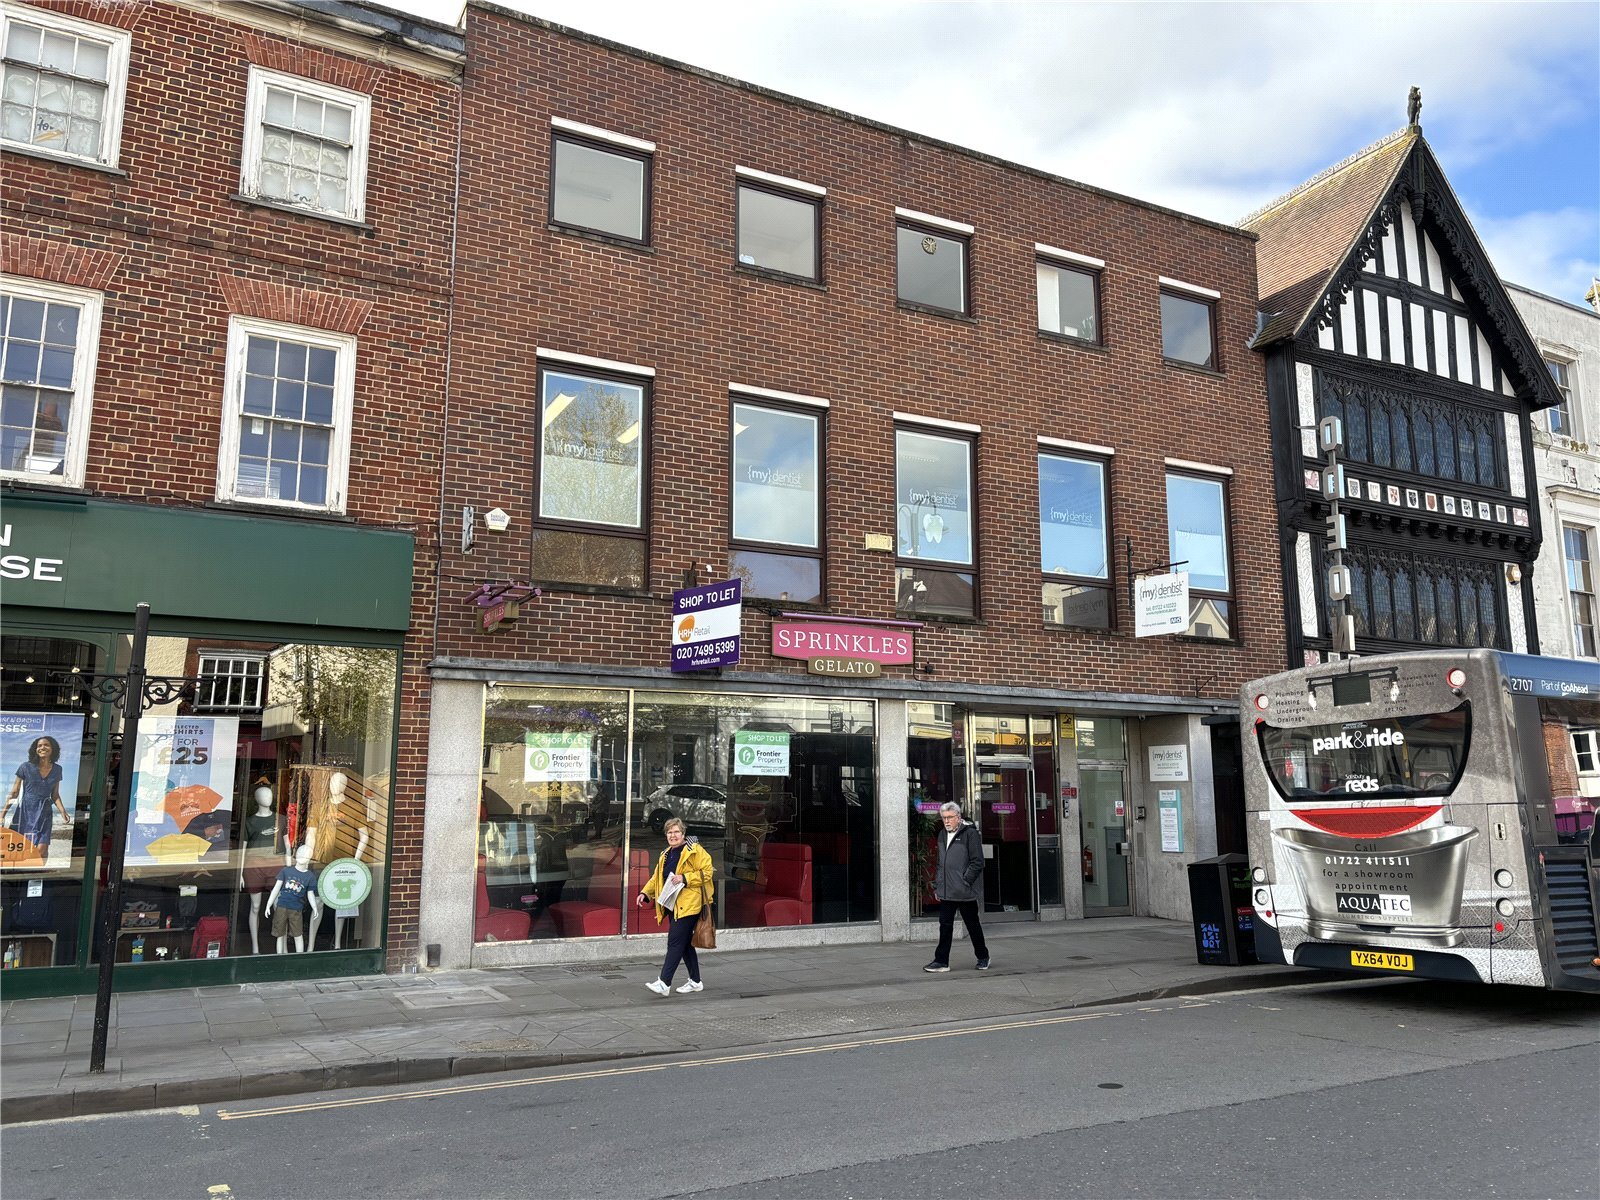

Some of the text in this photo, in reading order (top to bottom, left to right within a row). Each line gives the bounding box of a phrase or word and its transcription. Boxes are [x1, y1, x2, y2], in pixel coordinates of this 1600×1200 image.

[680, 587, 735, 608] SHOP TO LET
[679, 625, 711, 638] HRH Retail
[676, 640, 735, 659] 020 7499 5399
[778, 629, 908, 656] SPRINKLES
[691, 656, 720, 666] hrhretail.com
[814, 659, 875, 674] GELATO
[1511, 678, 1533, 692] 2707
[1541, 680, 1554, 691] Part
[1561, 682, 1589, 694] GoAhead
[1275, 690, 1304, 698] Plumbing
[1277, 706, 1318, 714] Underground
[1277, 716, 1306, 724] Drainage
[1312, 728, 1404, 755] park&ride
[158, 747, 208, 765] £25
[1345, 776, 1379, 792] reds
[1354, 843, 1377, 852] Call
[1325, 856, 1410, 866] 01722 411511
[1323, 869, 1338, 877] for
[1354, 870, 1414, 879] showroom
[1335, 882, 1408, 892] appointment
[1339, 896, 1410, 912] AQUATEC
[1356, 952, 1408, 967] YX64 VOJ
